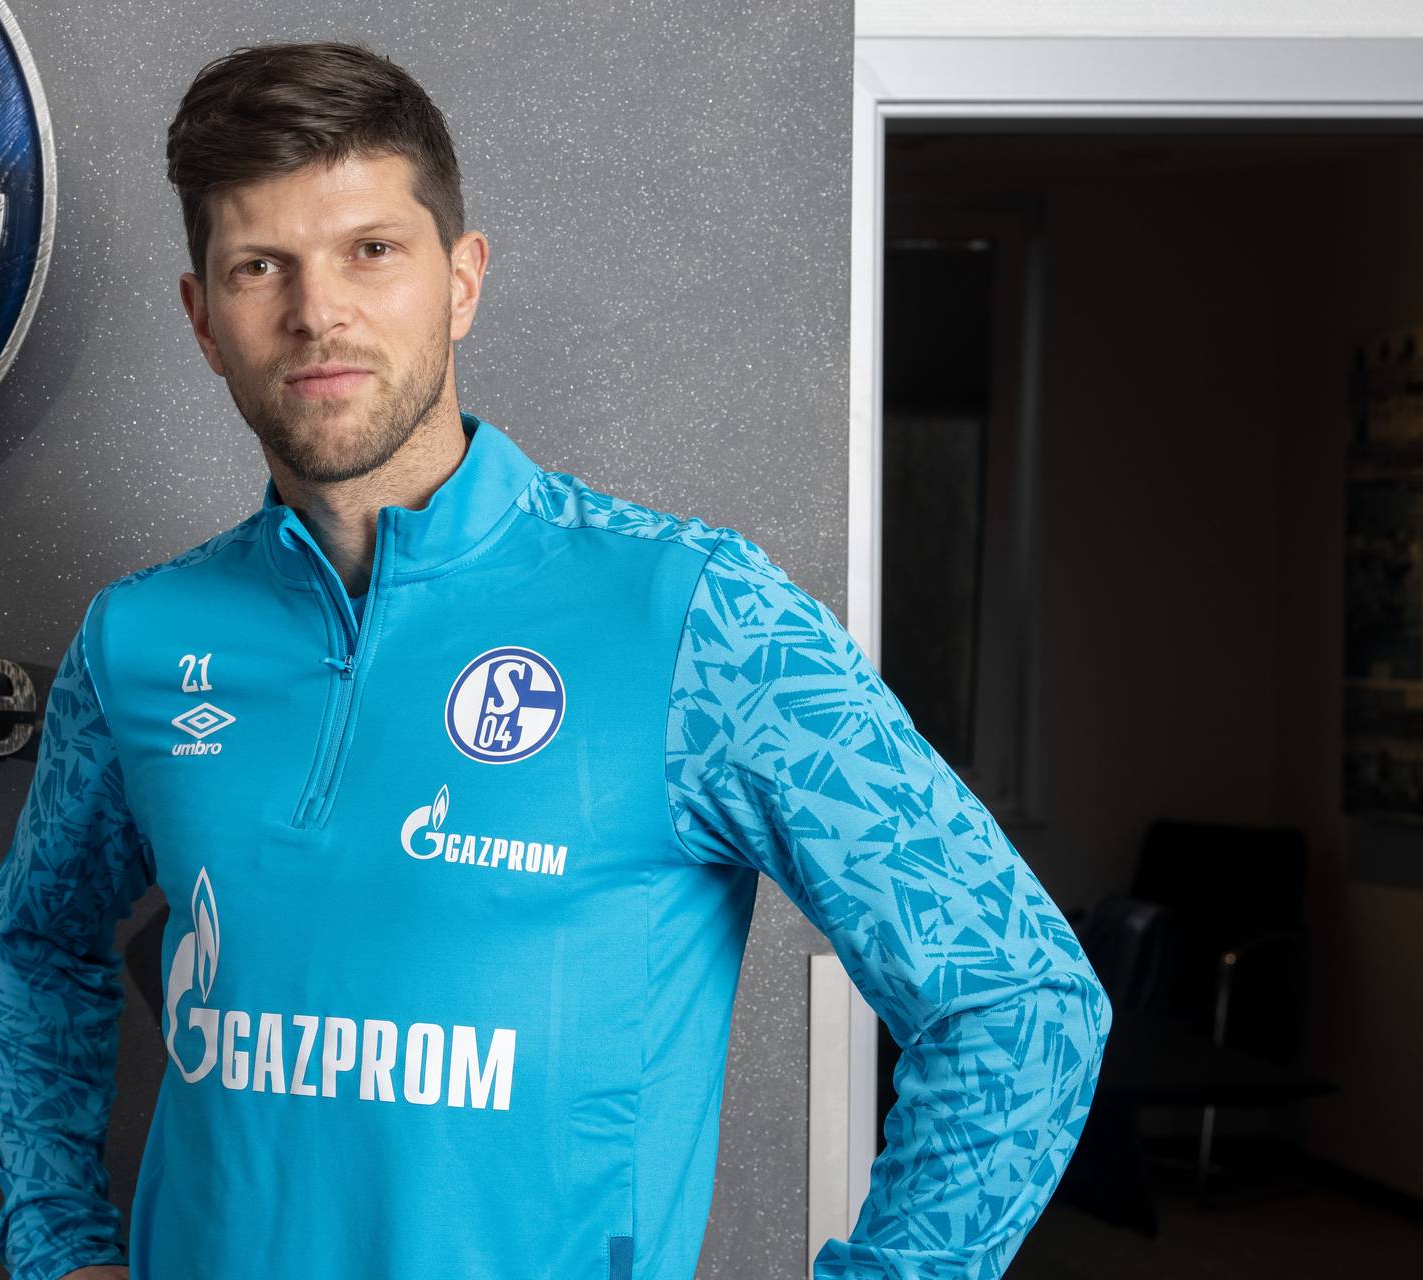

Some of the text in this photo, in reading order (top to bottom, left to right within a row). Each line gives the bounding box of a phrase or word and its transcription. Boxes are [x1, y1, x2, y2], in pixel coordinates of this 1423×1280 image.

[178, 653, 213, 693] 21
[485, 661, 526, 715] S
[171, 740, 223, 756] umbro
[478, 715, 512, 749] 04
[444, 833, 568, 876] GAZPROM
[221, 1010, 517, 1111] GAZPROM
